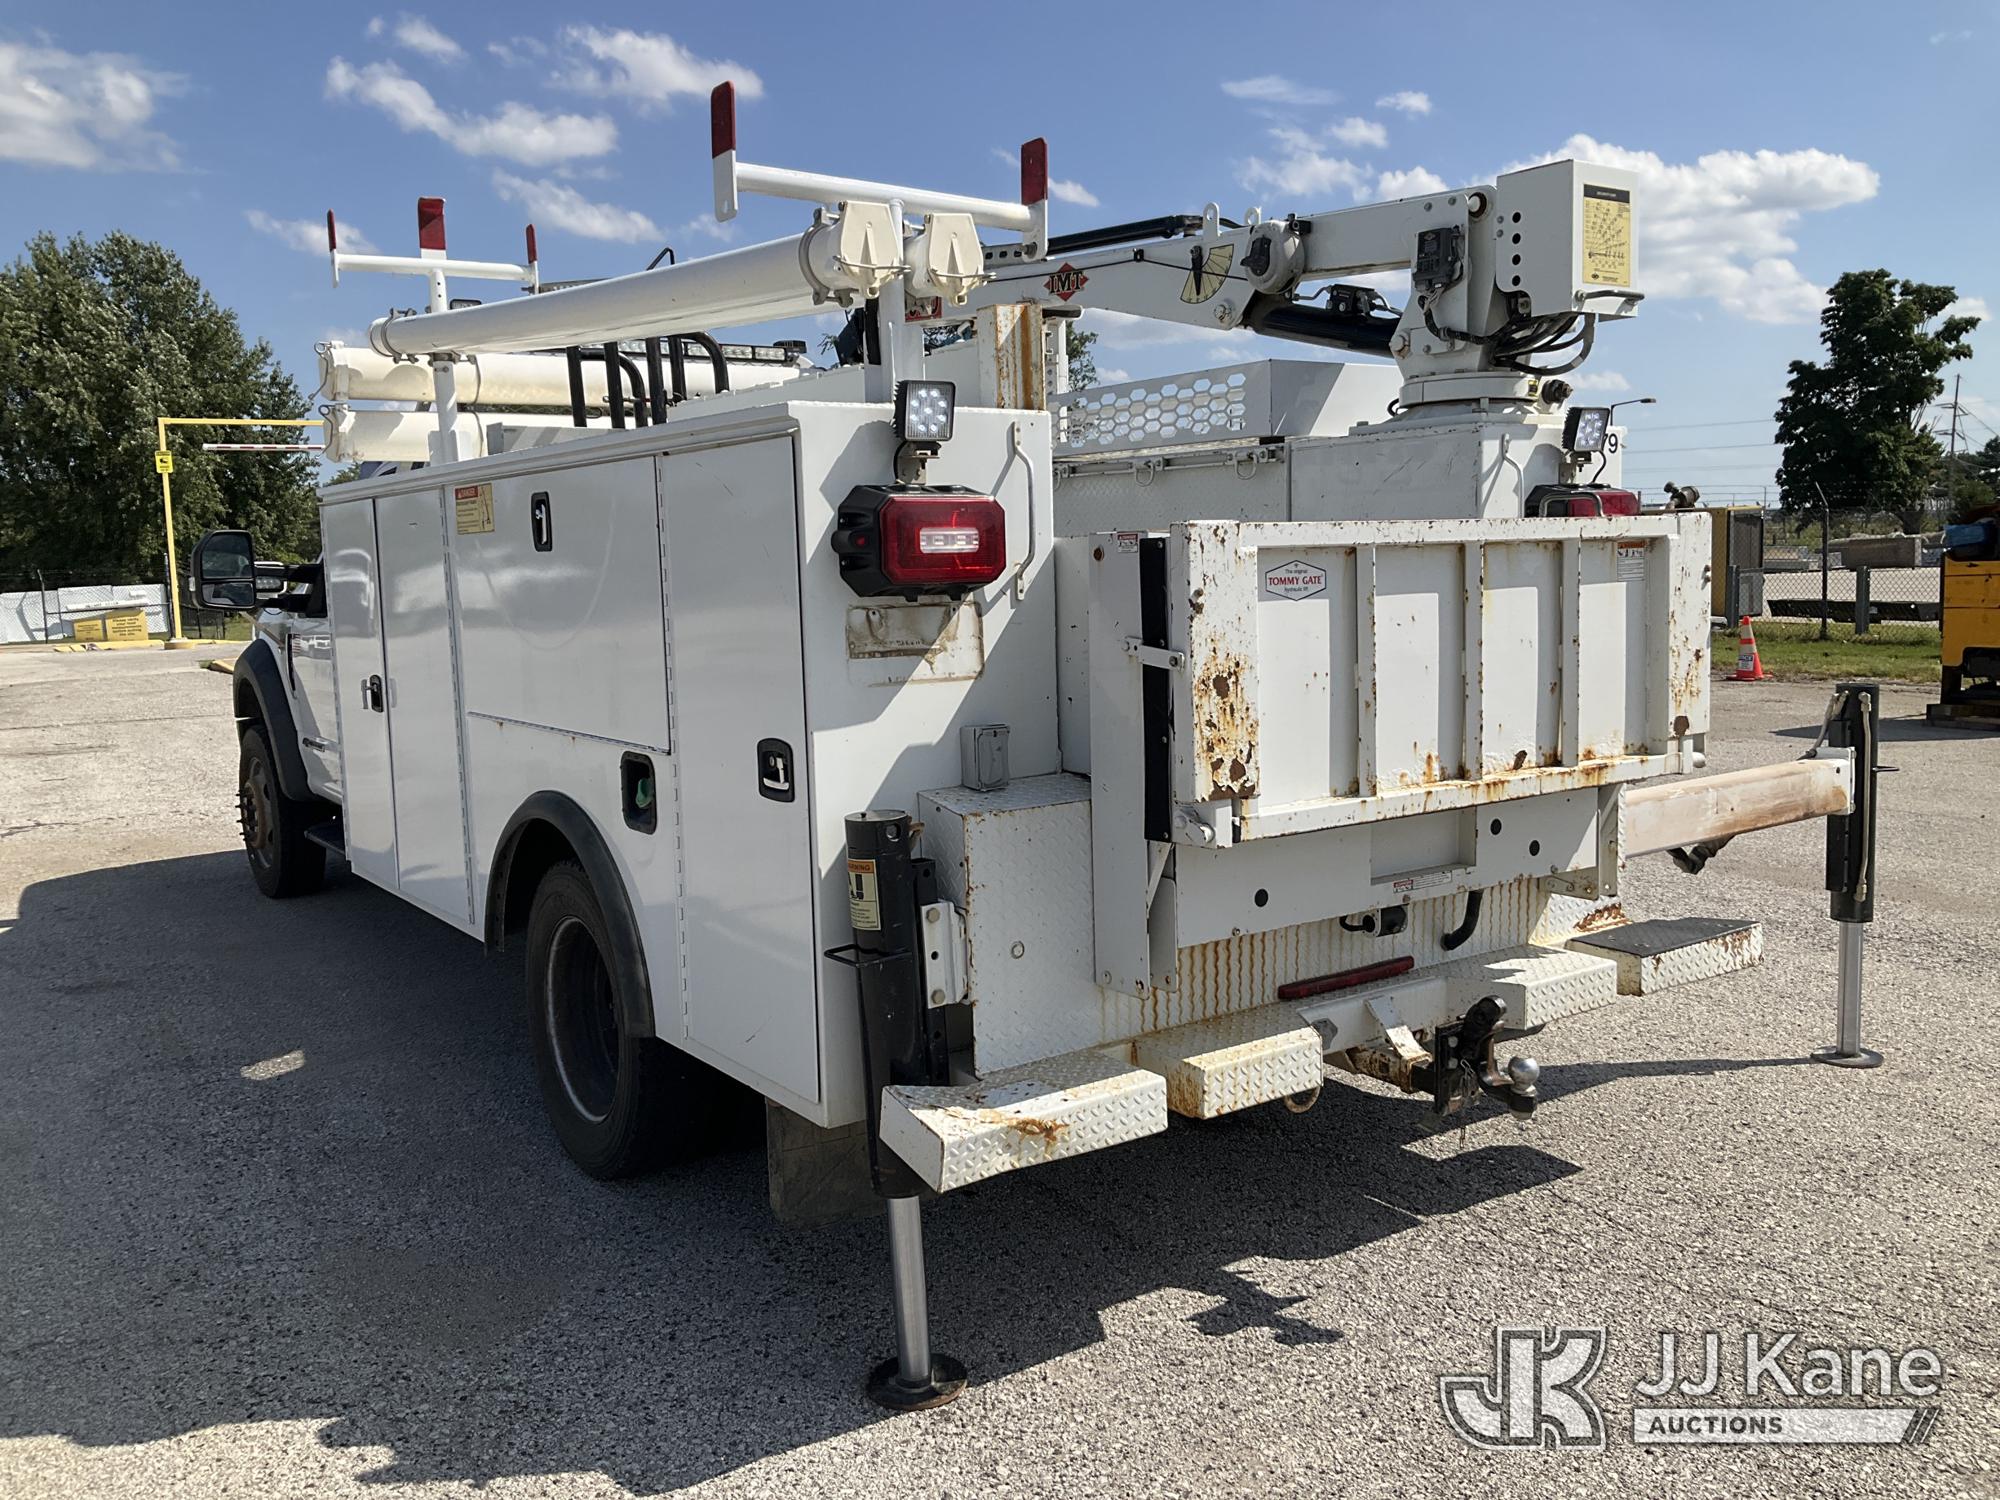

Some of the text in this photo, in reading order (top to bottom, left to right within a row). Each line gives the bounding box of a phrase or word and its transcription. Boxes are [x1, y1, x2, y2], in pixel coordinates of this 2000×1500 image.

[1050, 271, 1083, 294] IMT
[1268, 575, 1322, 586] TOMMY GATE
